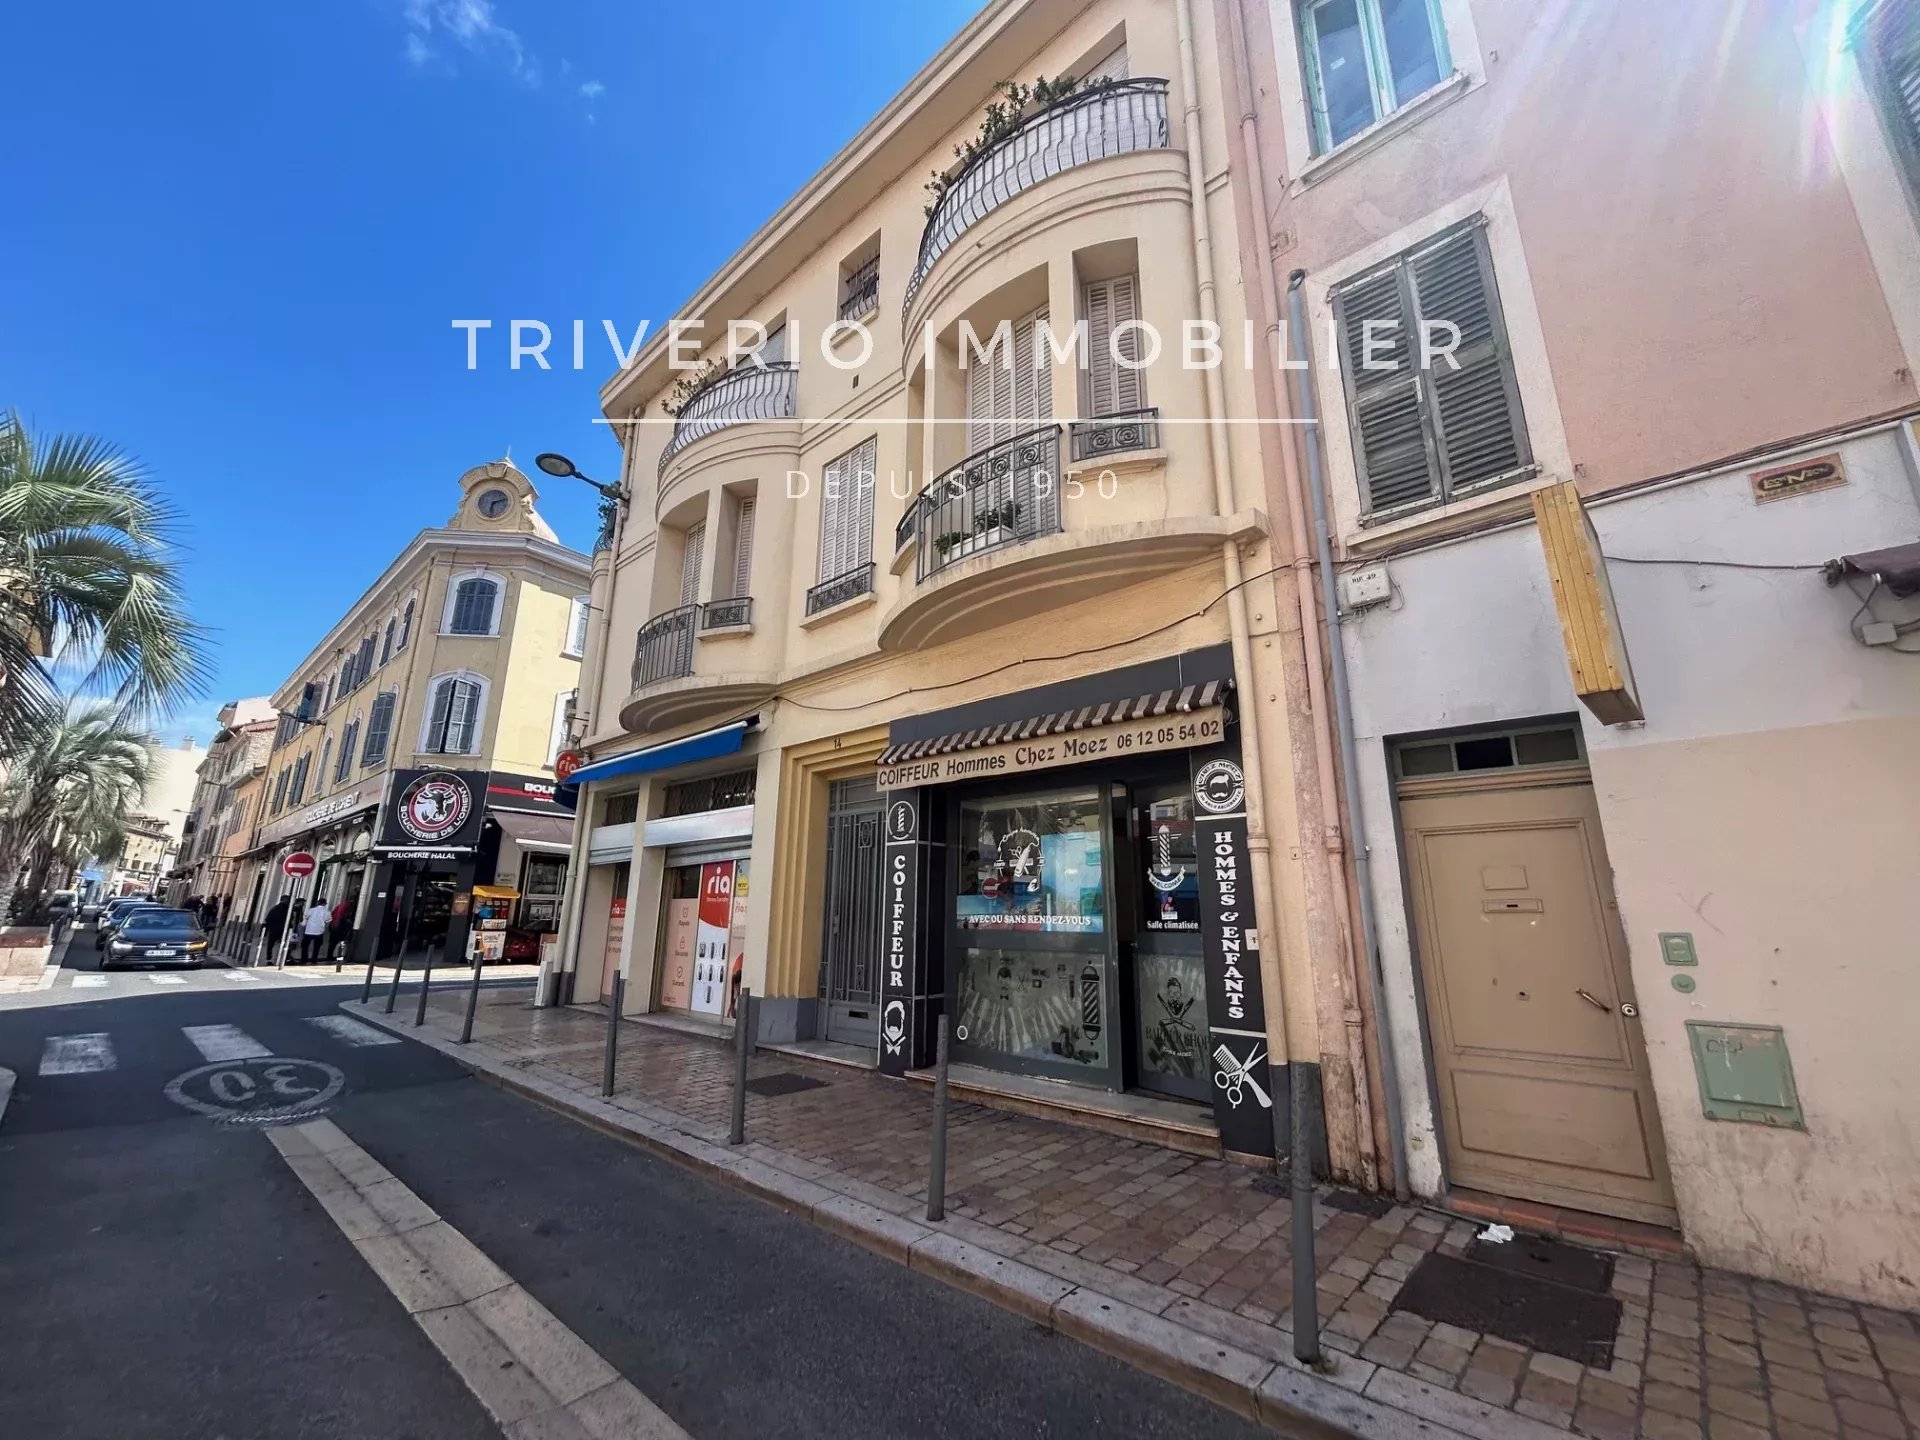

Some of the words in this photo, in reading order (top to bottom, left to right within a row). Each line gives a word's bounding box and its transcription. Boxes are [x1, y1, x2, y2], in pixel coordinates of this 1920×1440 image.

[558, 756, 577, 774] ria
[879, 762, 940, 786] COIFFEUR
[946, 755, 1006, 775] Hommes
[1015, 747, 1055, 766] Chez
[1063, 737, 1108, 758] Moez
[1117, 734, 1132, 749] 06
[1136, 730, 1153, 746] 12
[1157, 727, 1174, 744] 05
[1179, 723, 1196, 740] 54
[1201, 720, 1219, 738] 02
[400, 805, 438, 839] BOUCHERIE
[440, 825, 455, 837] DE
[453, 786, 471, 827] L'ORIENT
[387, 851, 430, 859] BOUCHERIE
[430, 852, 456, 860] HALAL
[1213, 831, 1237, 906] HOMMES
[707, 866, 731, 895] ria
[1150, 876, 1182, 889] WELCOME
[889, 855, 906, 987] COIFFEUR
[968, 915, 991, 923] AVEC
[990, 915, 1003, 923] OU
[1003, 915, 1027, 924] SANS
[1027, 915, 1091, 926] RENDEZ-VOUS
[1146, 920, 1163, 929] Salle
[1163, 921, 1199, 929] climatisée
[1219, 911, 1239, 922] &
[1221, 926, 1245, 1019] ENFANTS
[208, 1064, 321, 1102] 30
